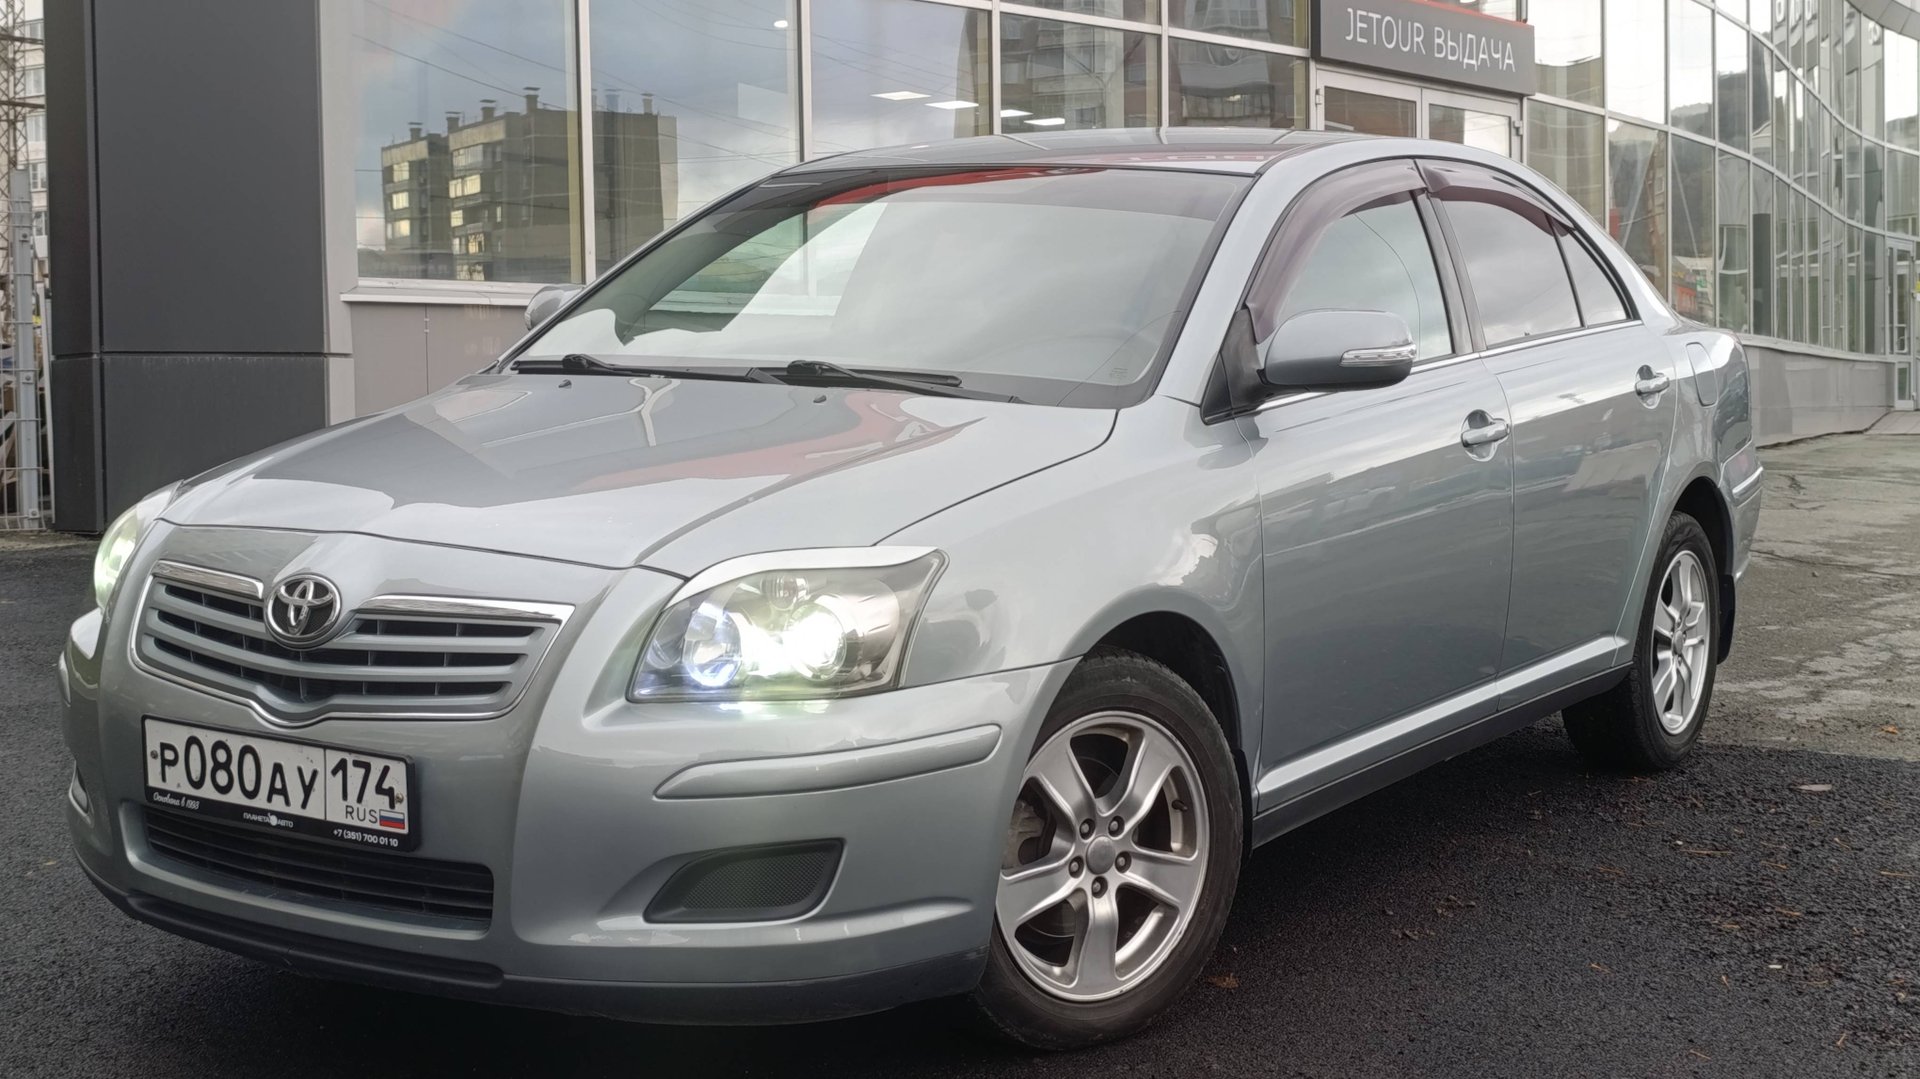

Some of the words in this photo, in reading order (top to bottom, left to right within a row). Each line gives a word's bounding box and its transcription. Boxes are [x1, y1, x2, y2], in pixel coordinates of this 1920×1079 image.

[1345, 7, 1426, 55] JETOUR
[1434, 26, 1516, 72] ВЫДАЧА
[331, 758, 396, 810] 174
[345, 805, 378, 824] RUS
[333, 829, 342, 837] +7
[343, 829, 362, 841] (351)
[363, 833, 378, 843] 700
